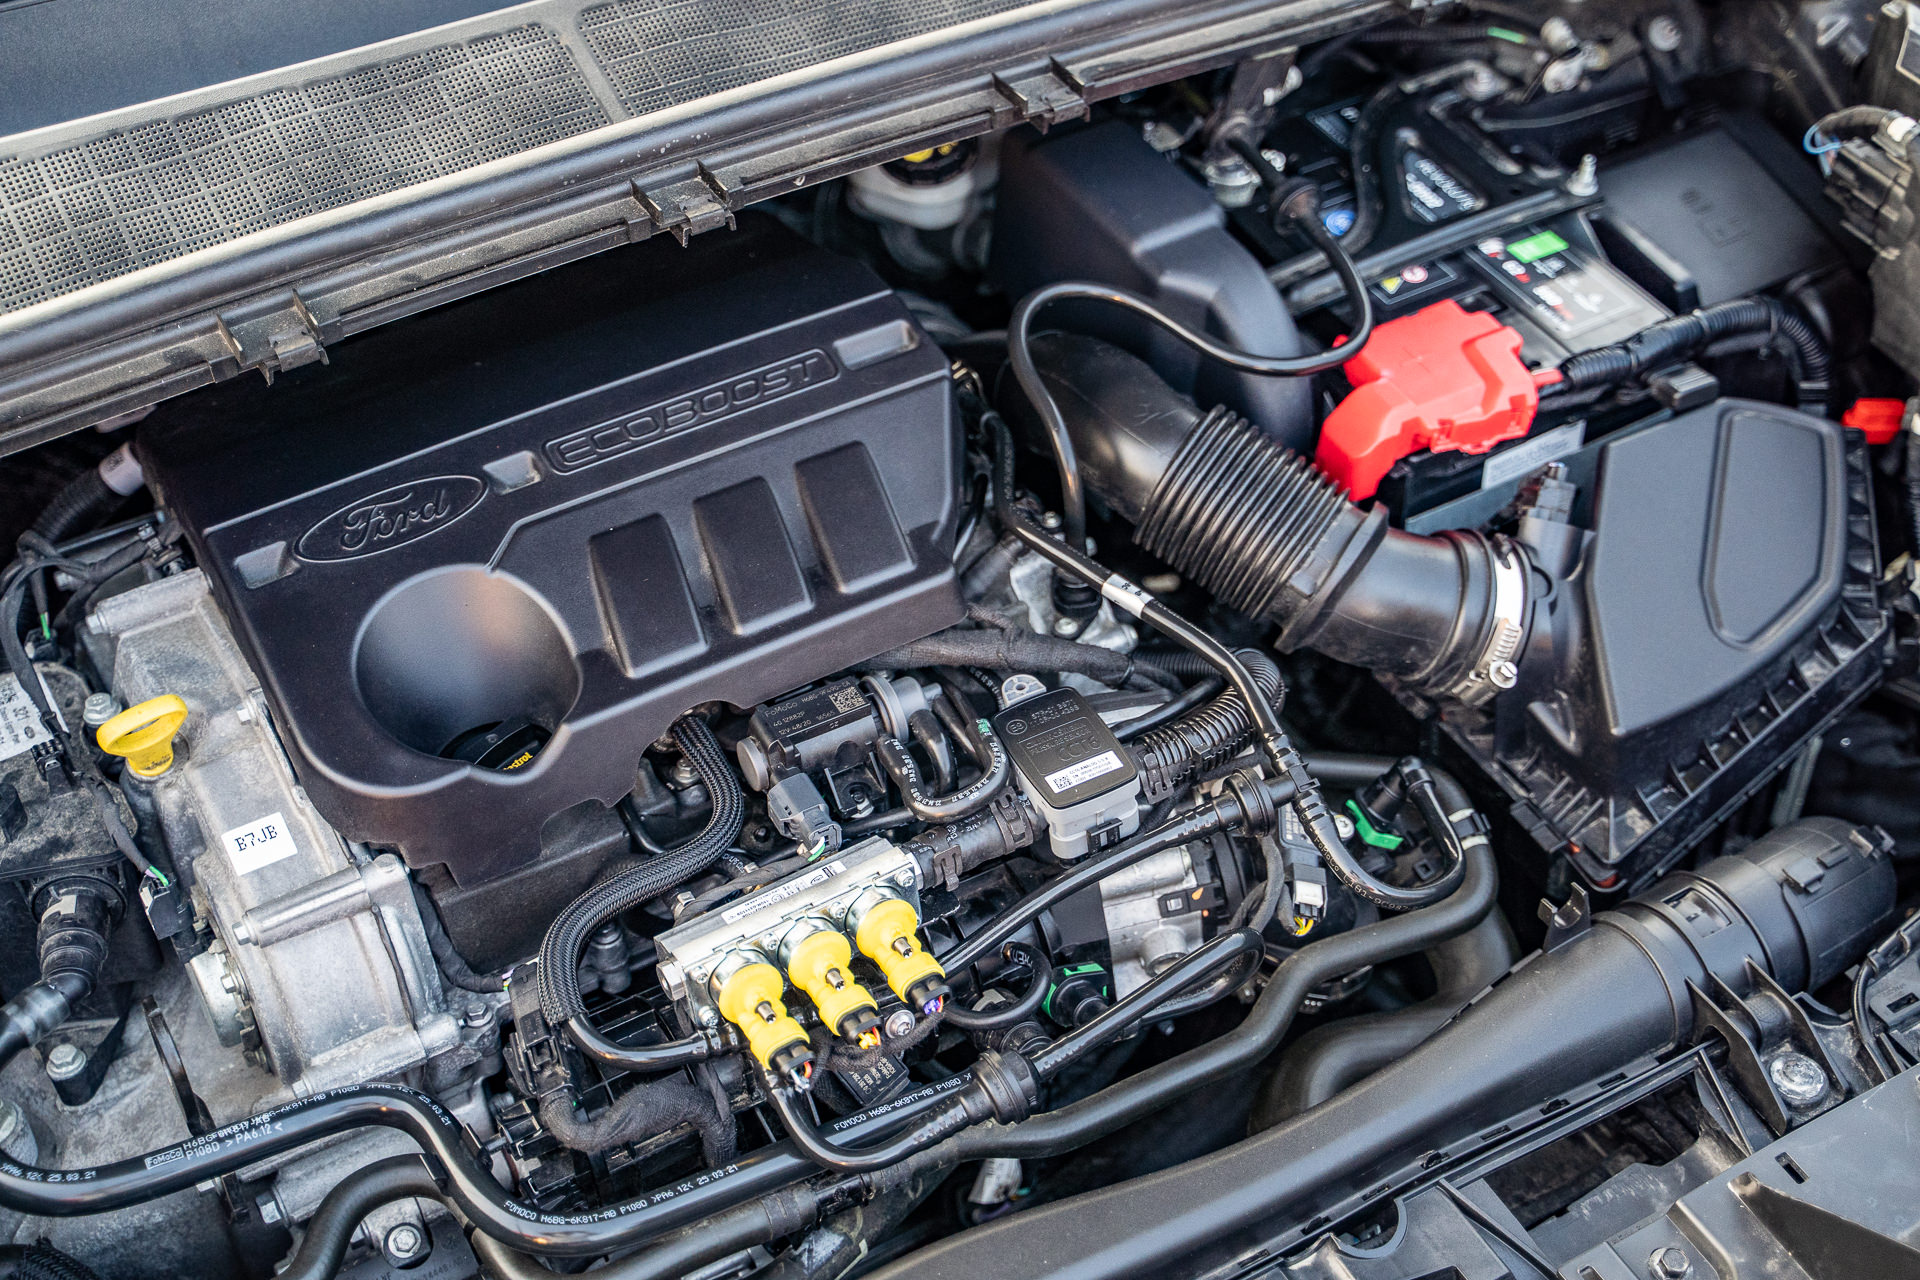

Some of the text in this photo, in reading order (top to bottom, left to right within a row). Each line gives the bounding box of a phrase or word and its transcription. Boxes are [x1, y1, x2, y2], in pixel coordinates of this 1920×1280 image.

[556, 354, 822, 467] ECOBOOST
[339, 488, 450, 552] Ford
[764, 701, 798, 718] FoMoCo
[234, 825, 278, 852] B7JB
[146, 1149, 182, 1167] FoMoCo
[186, 1140, 220, 1160] P108D
